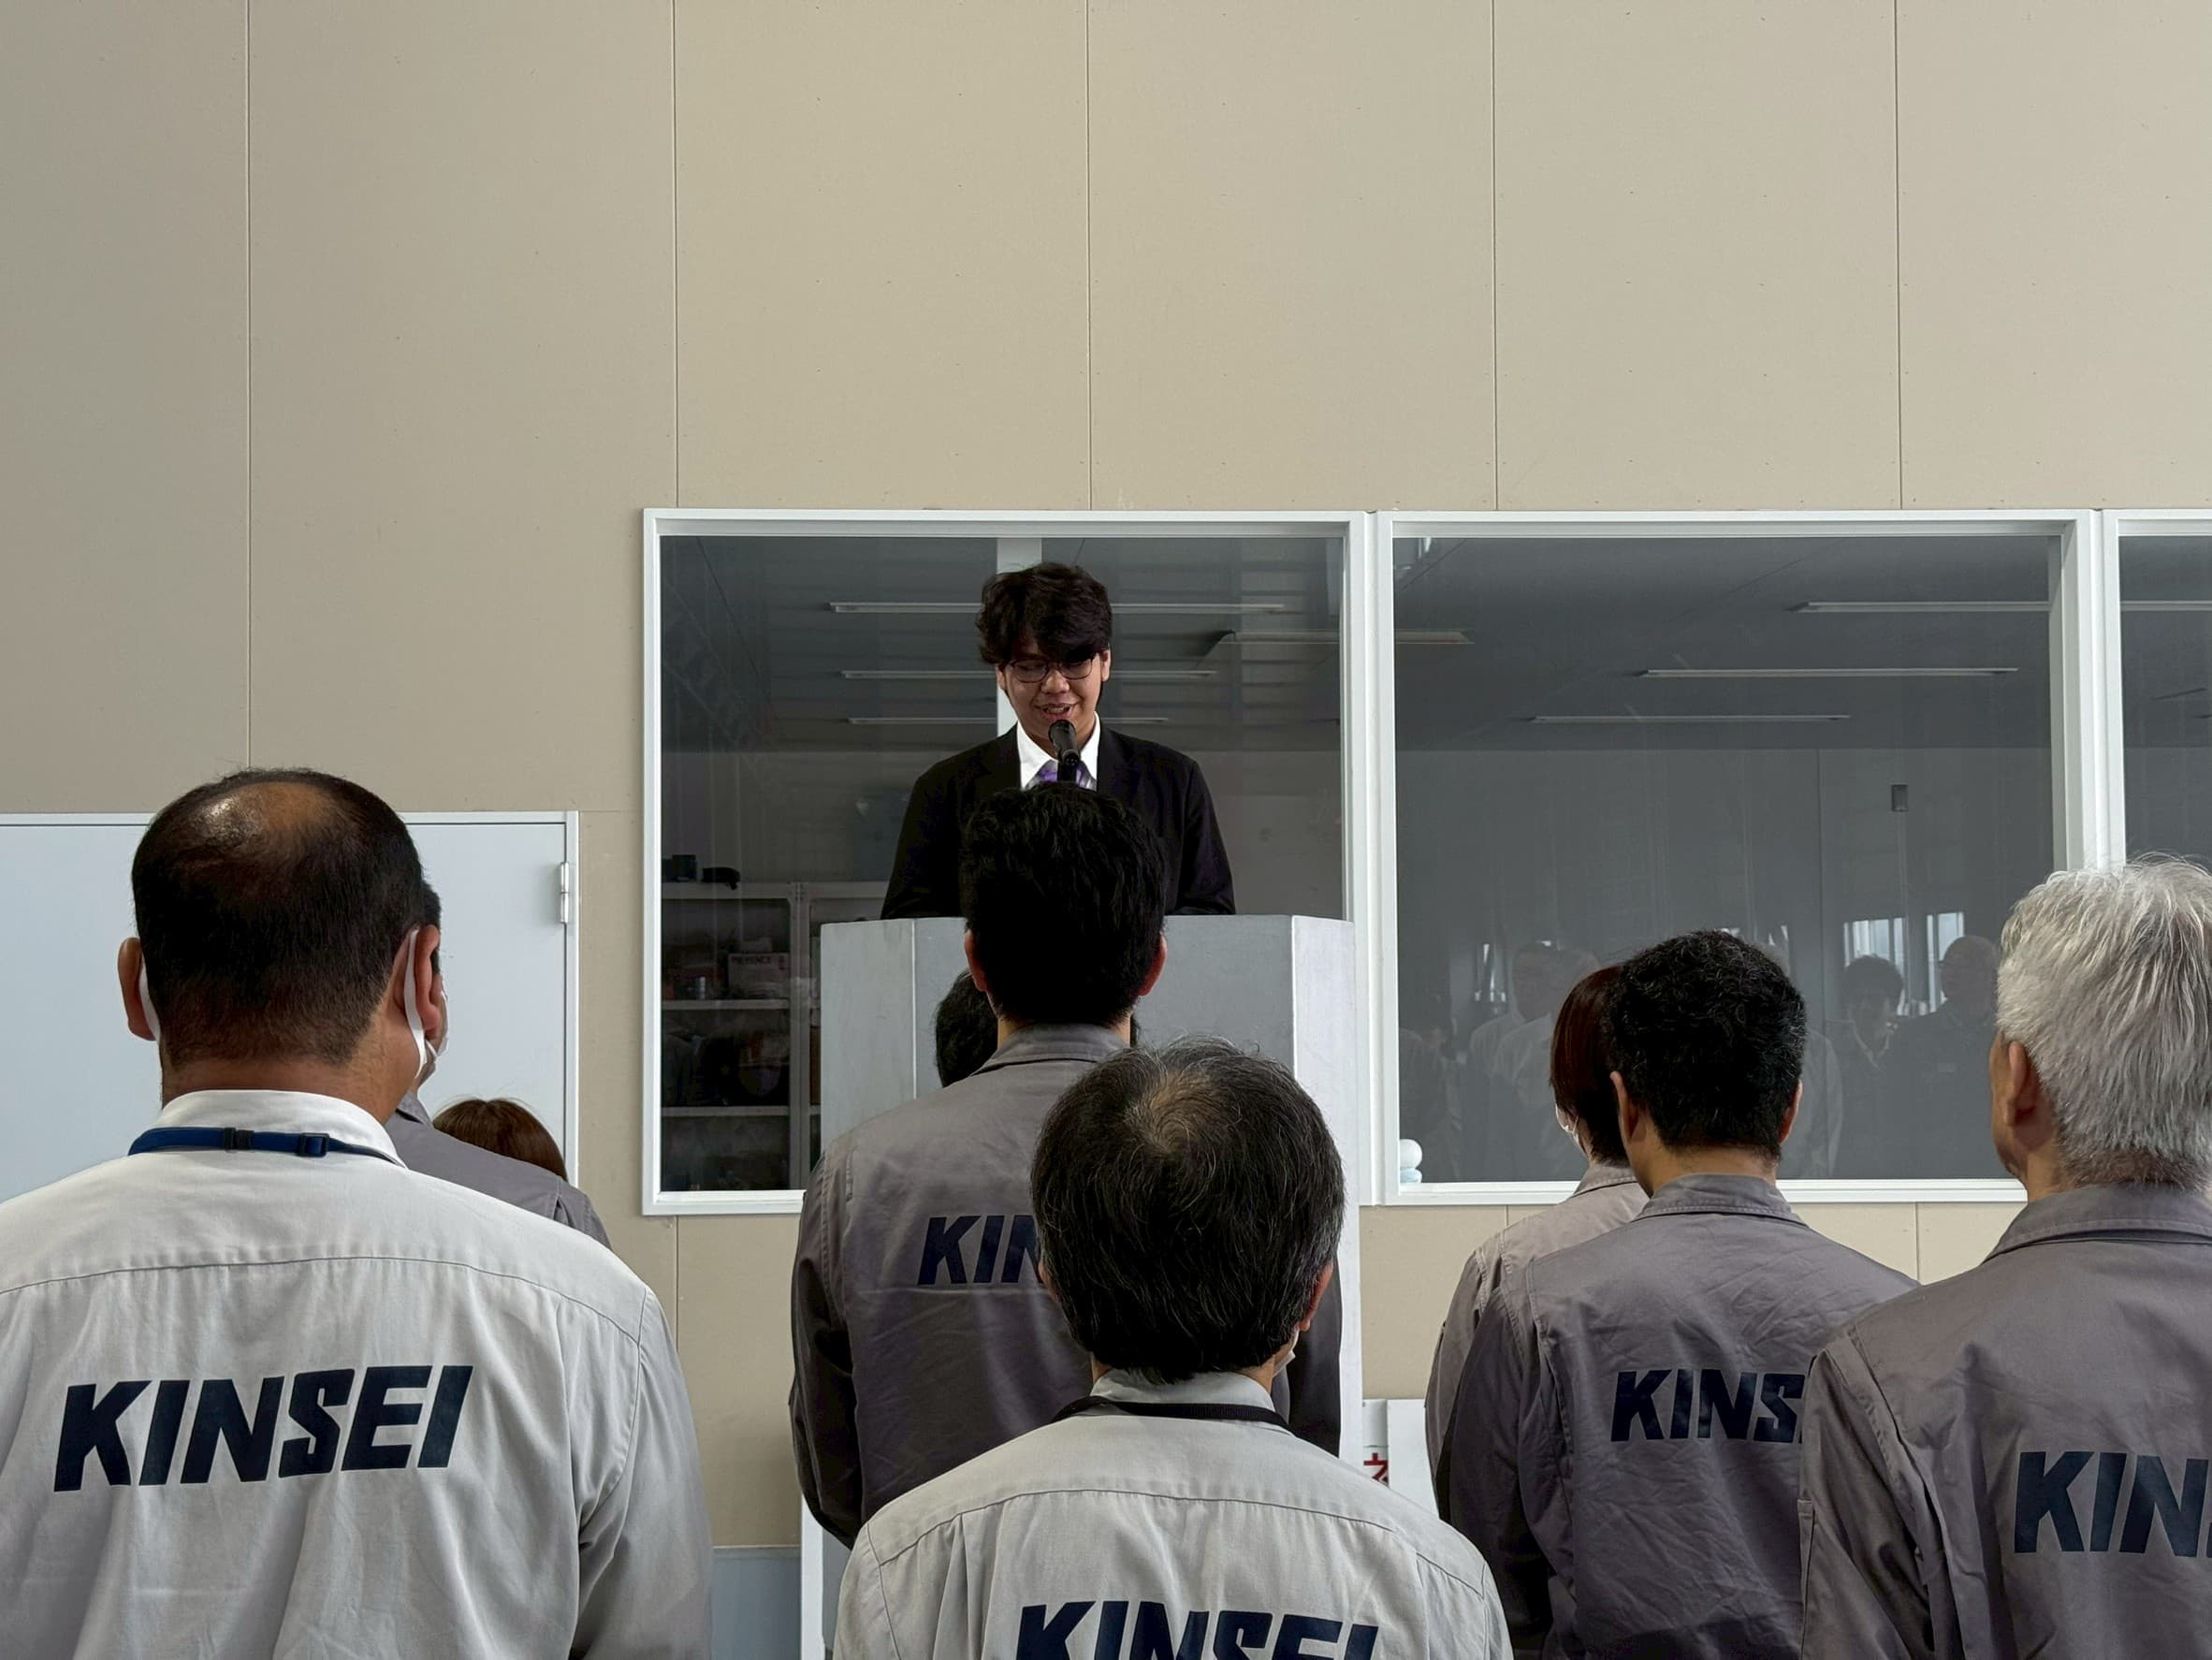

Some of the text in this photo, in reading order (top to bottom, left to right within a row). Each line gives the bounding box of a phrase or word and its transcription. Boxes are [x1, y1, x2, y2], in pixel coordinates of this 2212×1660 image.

[53, 1364, 473, 1492] KINSEI
[1610, 1369, 1806, 1444] KINS
[2014, 1451, 2212, 1558] KIN
